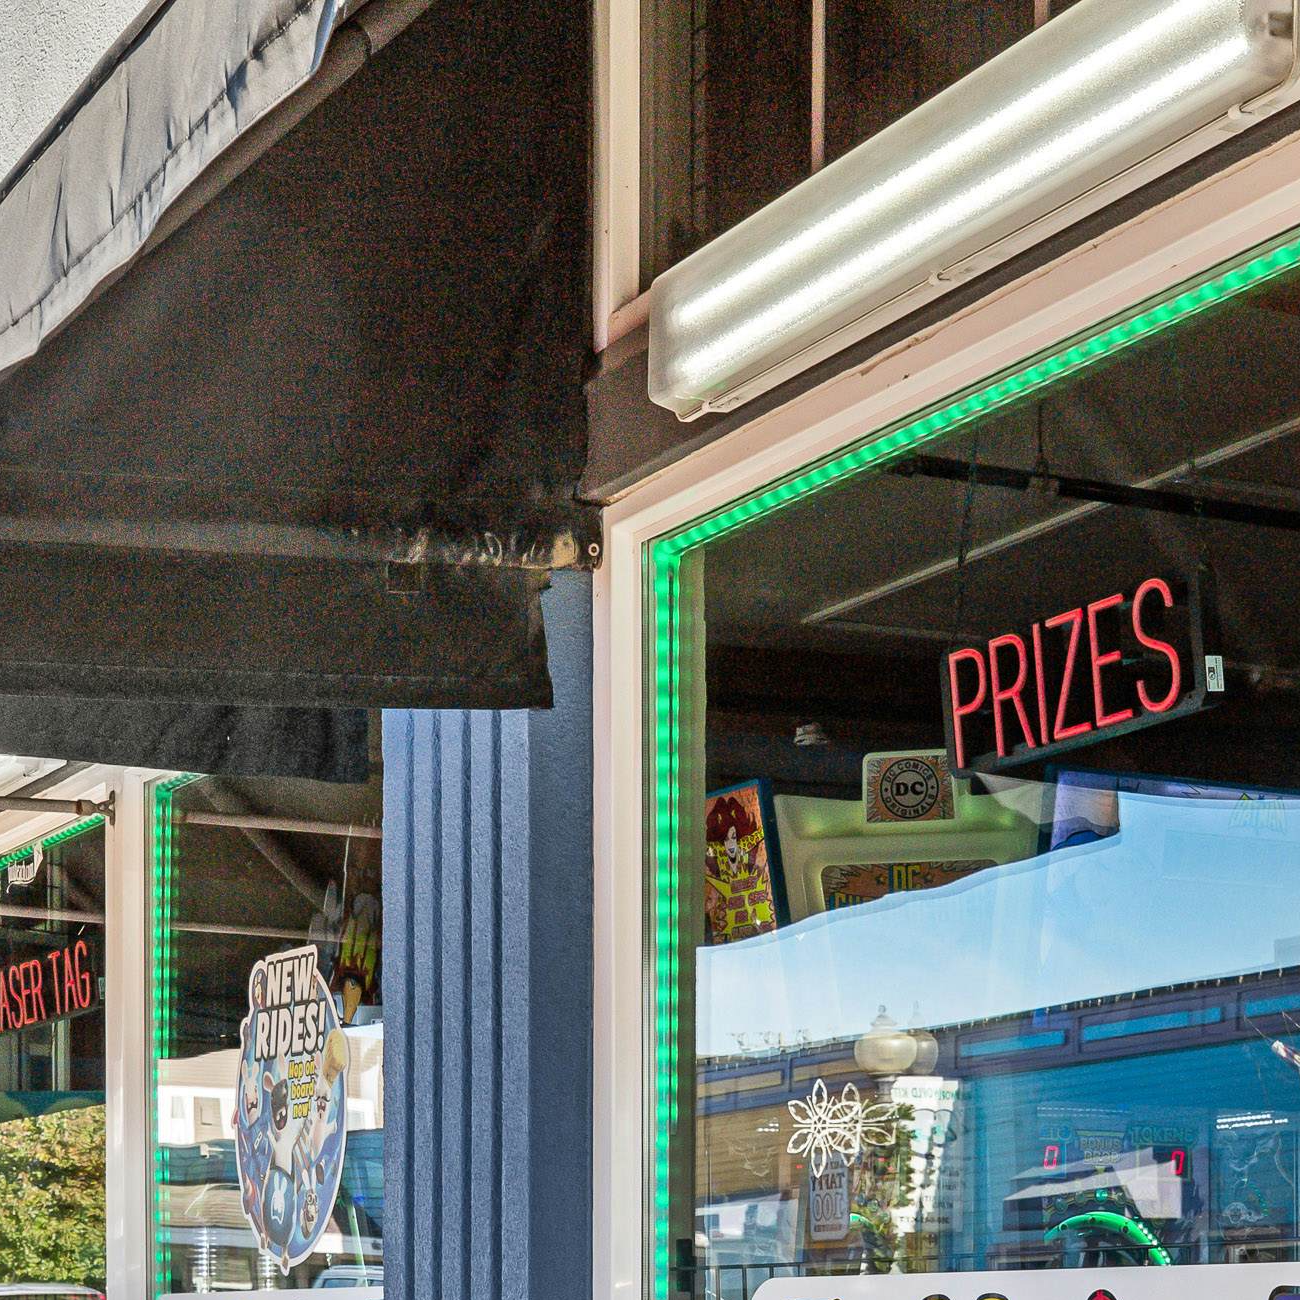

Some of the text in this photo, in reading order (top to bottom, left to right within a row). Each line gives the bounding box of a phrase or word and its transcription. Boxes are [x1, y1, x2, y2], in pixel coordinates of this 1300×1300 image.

[947, 577, 1181, 769] PRIZES
[894, 781, 925, 797] DC
[48, 940, 91, 1015] TAG
[267, 953, 315, 1006] NEW
[255, 1000, 327, 1062] RIDES!
[288, 1057, 316, 1080] Hop on
[290, 1080, 315, 1101] board
[293, 1101, 312, 1119] now!
